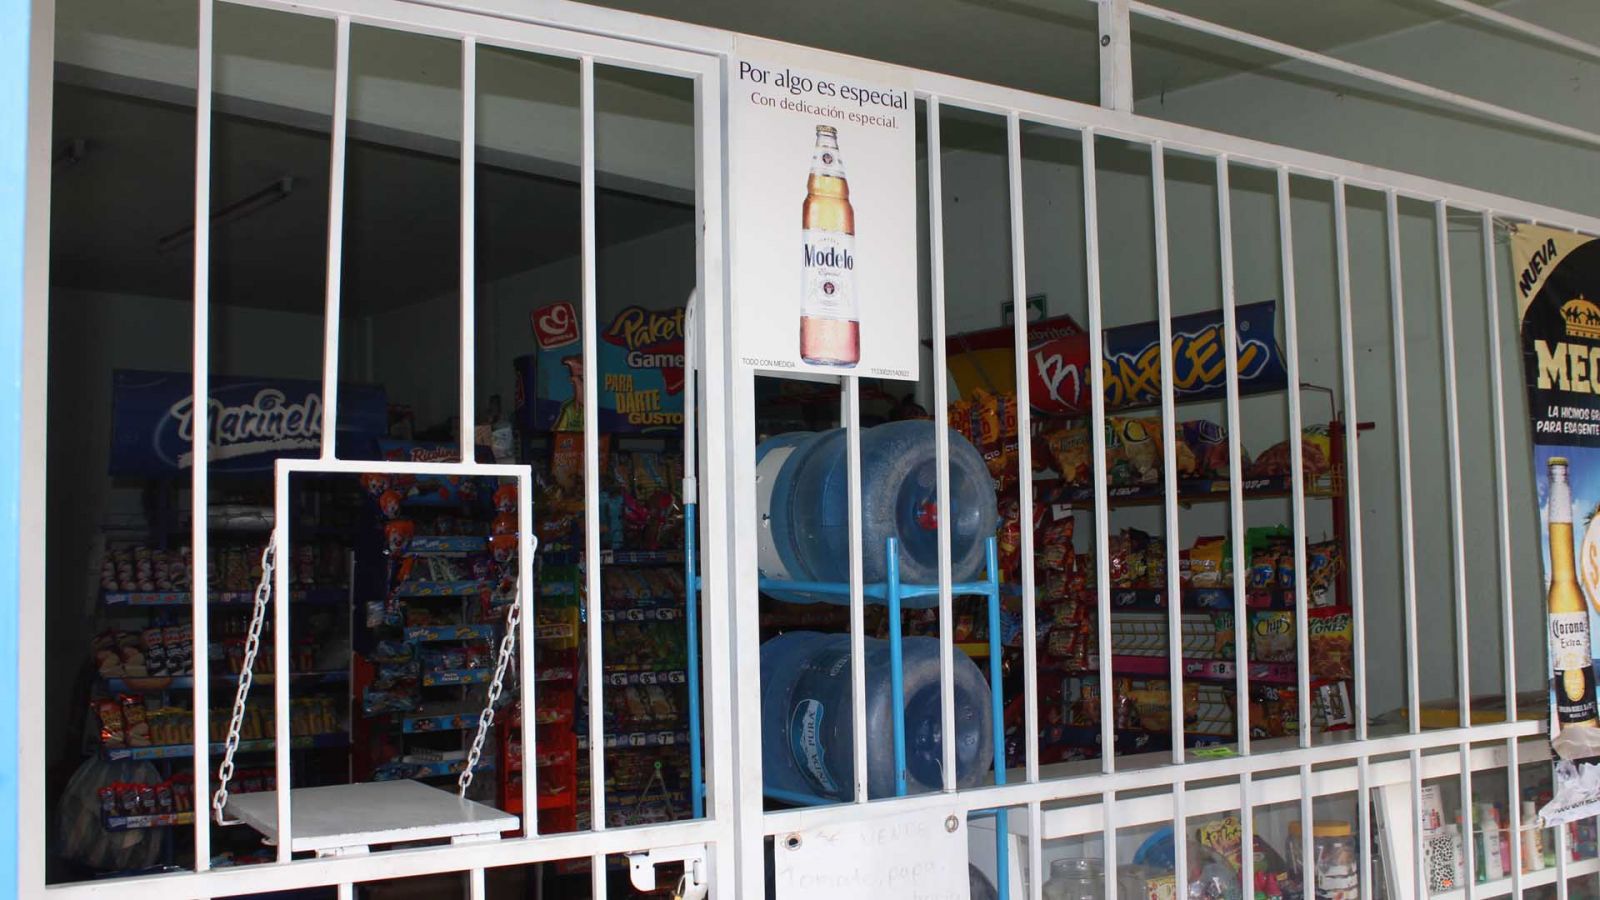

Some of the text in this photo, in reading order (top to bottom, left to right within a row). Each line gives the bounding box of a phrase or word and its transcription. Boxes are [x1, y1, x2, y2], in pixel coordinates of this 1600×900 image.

[739, 61, 908, 110] Por algo es especial
[751, 92, 899, 129] Con dedicación especial.
[804, 243, 854, 271] Modelo
[1518, 237, 1557, 298] NUEVA
[608, 307, 685, 350] Paket
[1027, 326, 1076, 341] abritas
[628, 351, 685, 369] Game
[742, 357, 796, 369] TODO CON MEDIDA
[1084, 327, 1258, 408] BARCEL
[605, 373, 633, 393] PARA
[628, 412, 684, 424] GUSTO
[1548, 405, 1559, 418] LA
[1537, 420, 1562, 433] PARA
[410, 445, 459, 462] Ricolin
[1553, 619, 1586, 639] Corona
[1560, 637, 1582, 649] Extra
